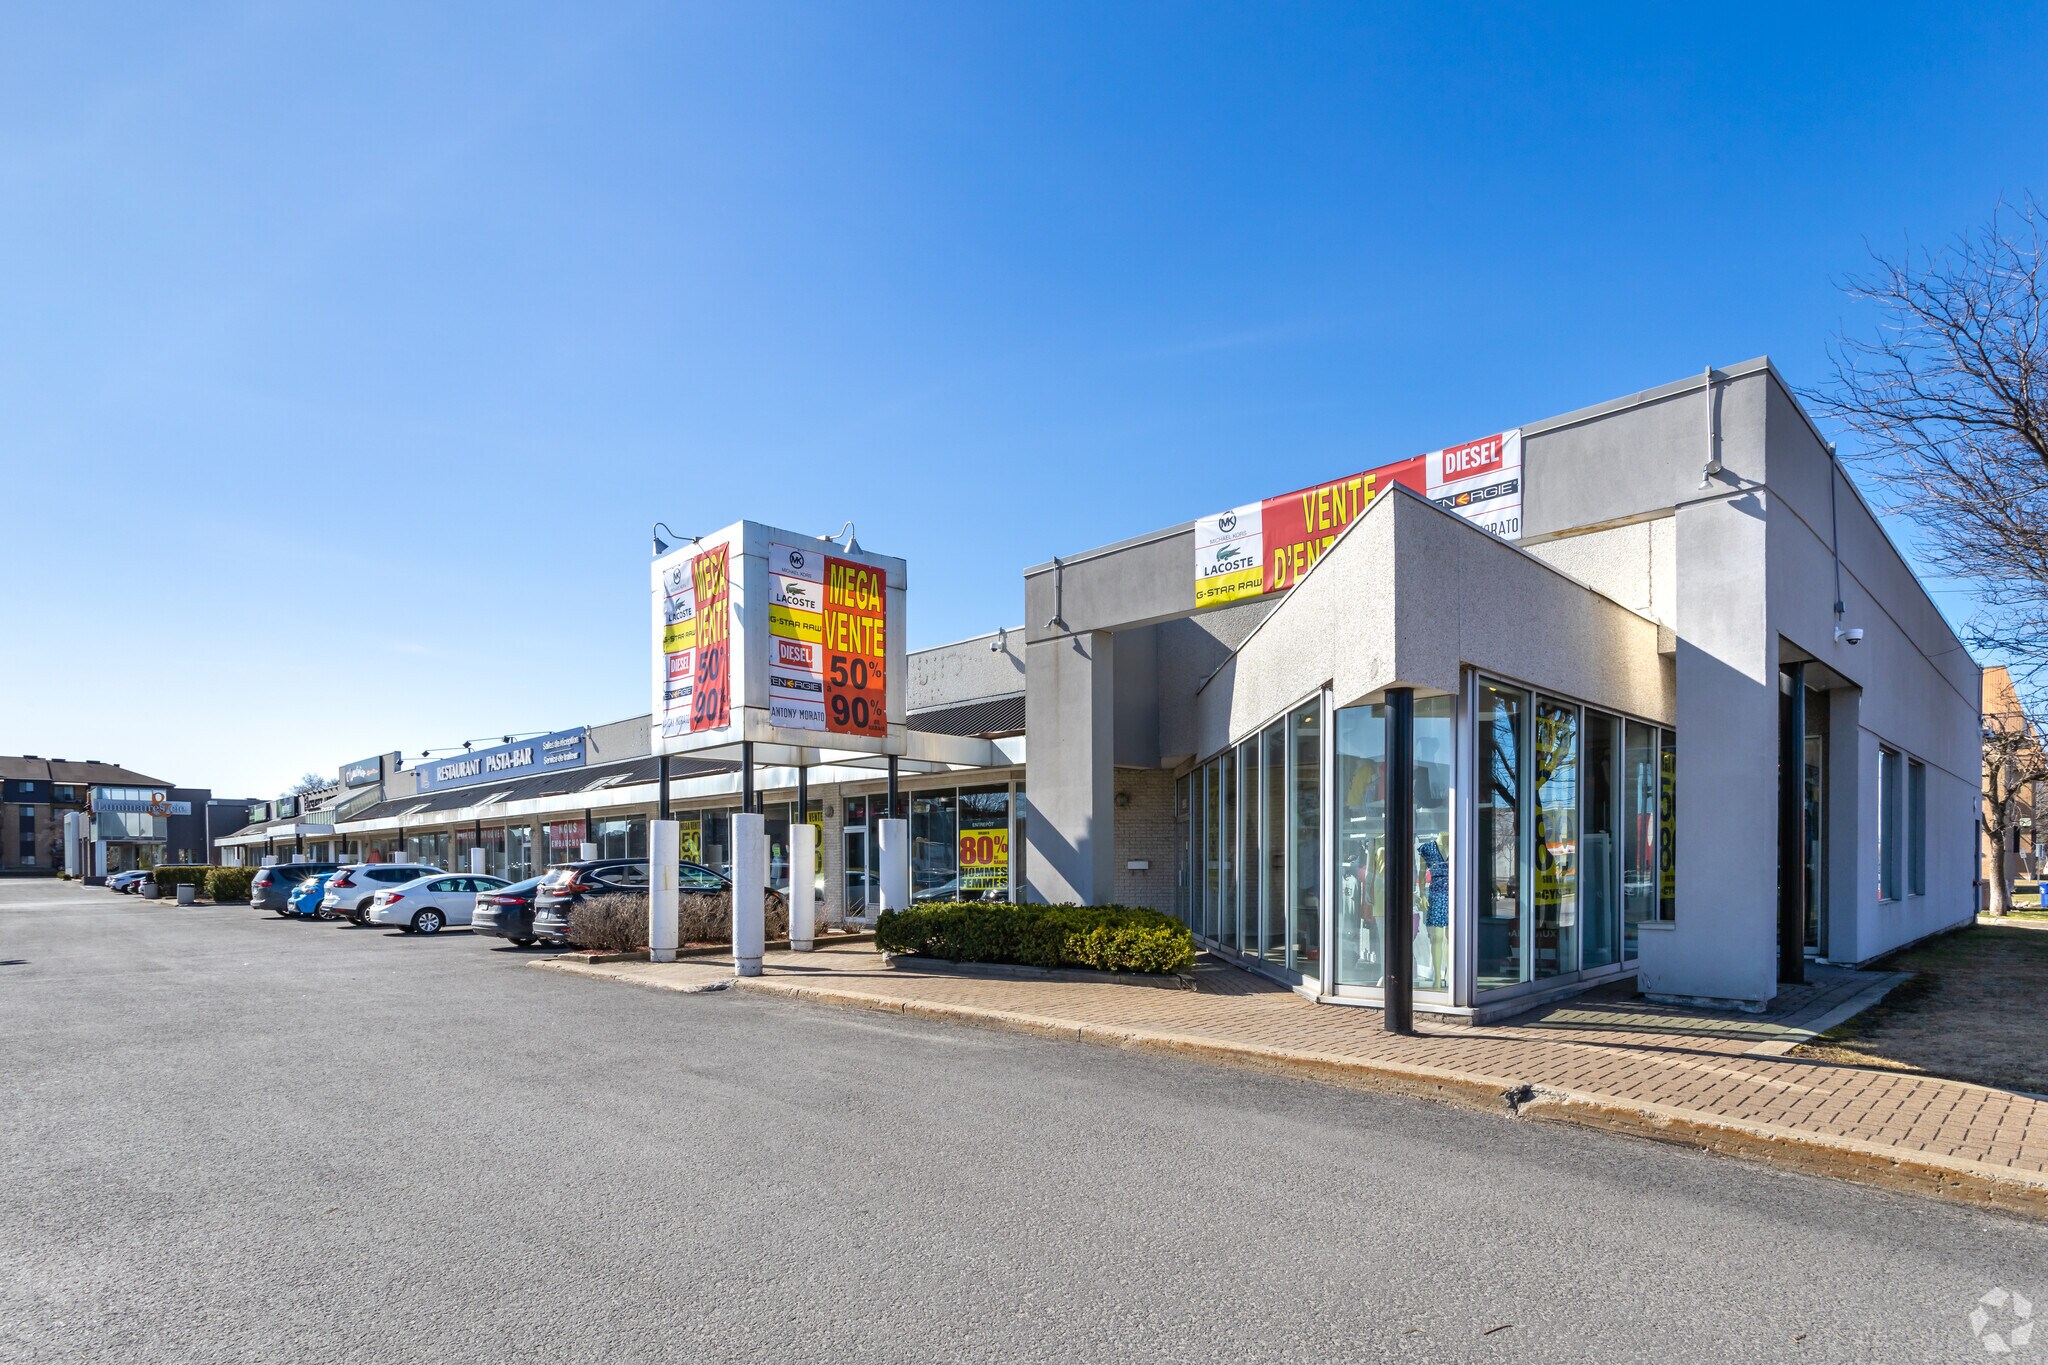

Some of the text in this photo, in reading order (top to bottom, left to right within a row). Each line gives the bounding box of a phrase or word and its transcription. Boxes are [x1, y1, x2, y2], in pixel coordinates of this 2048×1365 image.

[1445, 440, 1499, 475] DIESEL
[1480, 517, 1519, 536] RATO
[1209, 530, 1247, 545] MICHAEL KORS
[694, 551, 727, 602] MEGA
[1204, 556, 1253, 577] LACOSTE
[829, 563, 881, 613] MEGA
[1196, 578, 1263, 600] G-STAR RAW
[776, 593, 816, 609] LACOSTE
[668, 607, 692, 622] LACOSTE
[696, 597, 728, 648] VENTE
[770, 615, 822, 632] G-STAR RAW
[824, 609, 884, 658] VENTE
[780, 643, 813, 663] DIESEL
[670, 655, 690, 673] DIESEL
[830, 655, 882, 690] 50%
[770, 706, 825, 722] ANTONY MORATO
[831, 694, 882, 728] 90%
[436, 747, 532, 781] RESTAURANT PASTA-BAR
[98, 801, 165, 812] Luminaires
[559, 822, 577, 834] NOUS
[960, 835, 1008, 865] 80%
[961, 866, 1008, 878] HOMMES
[961, 878, 1008, 889] FEMMES
